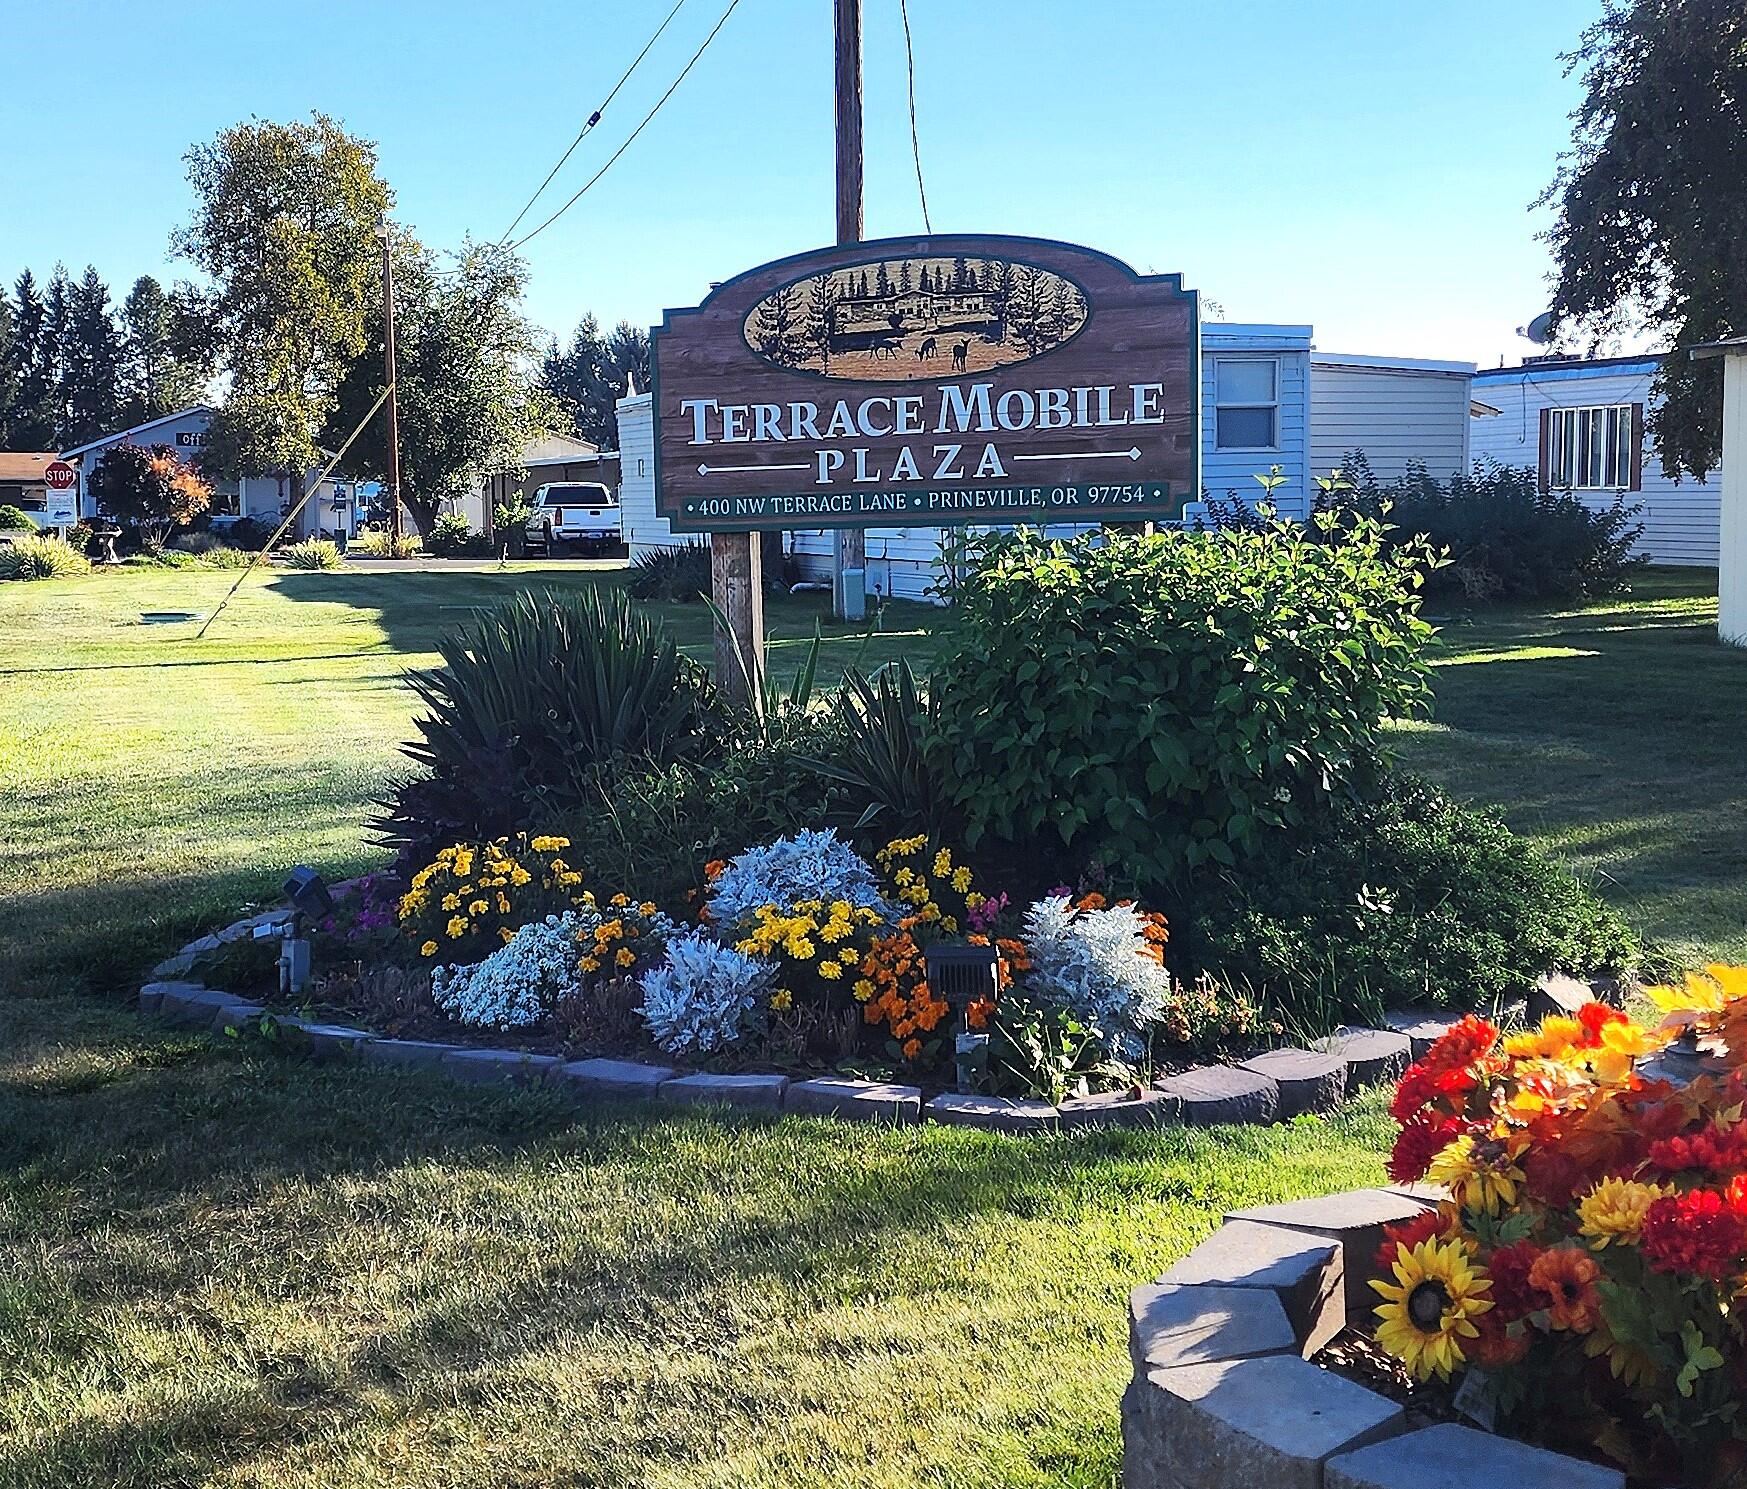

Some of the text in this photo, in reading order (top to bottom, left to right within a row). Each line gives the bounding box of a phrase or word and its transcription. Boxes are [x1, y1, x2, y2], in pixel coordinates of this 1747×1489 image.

[680, 383, 1166, 445] TERRACE MOBILE
[46, 470, 72, 481] STOP
[814, 442, 1009, 484] PLAZA
[698, 485, 1145, 516] 400 NW TERRACE LANE PRINEVILLE, OR 97754
